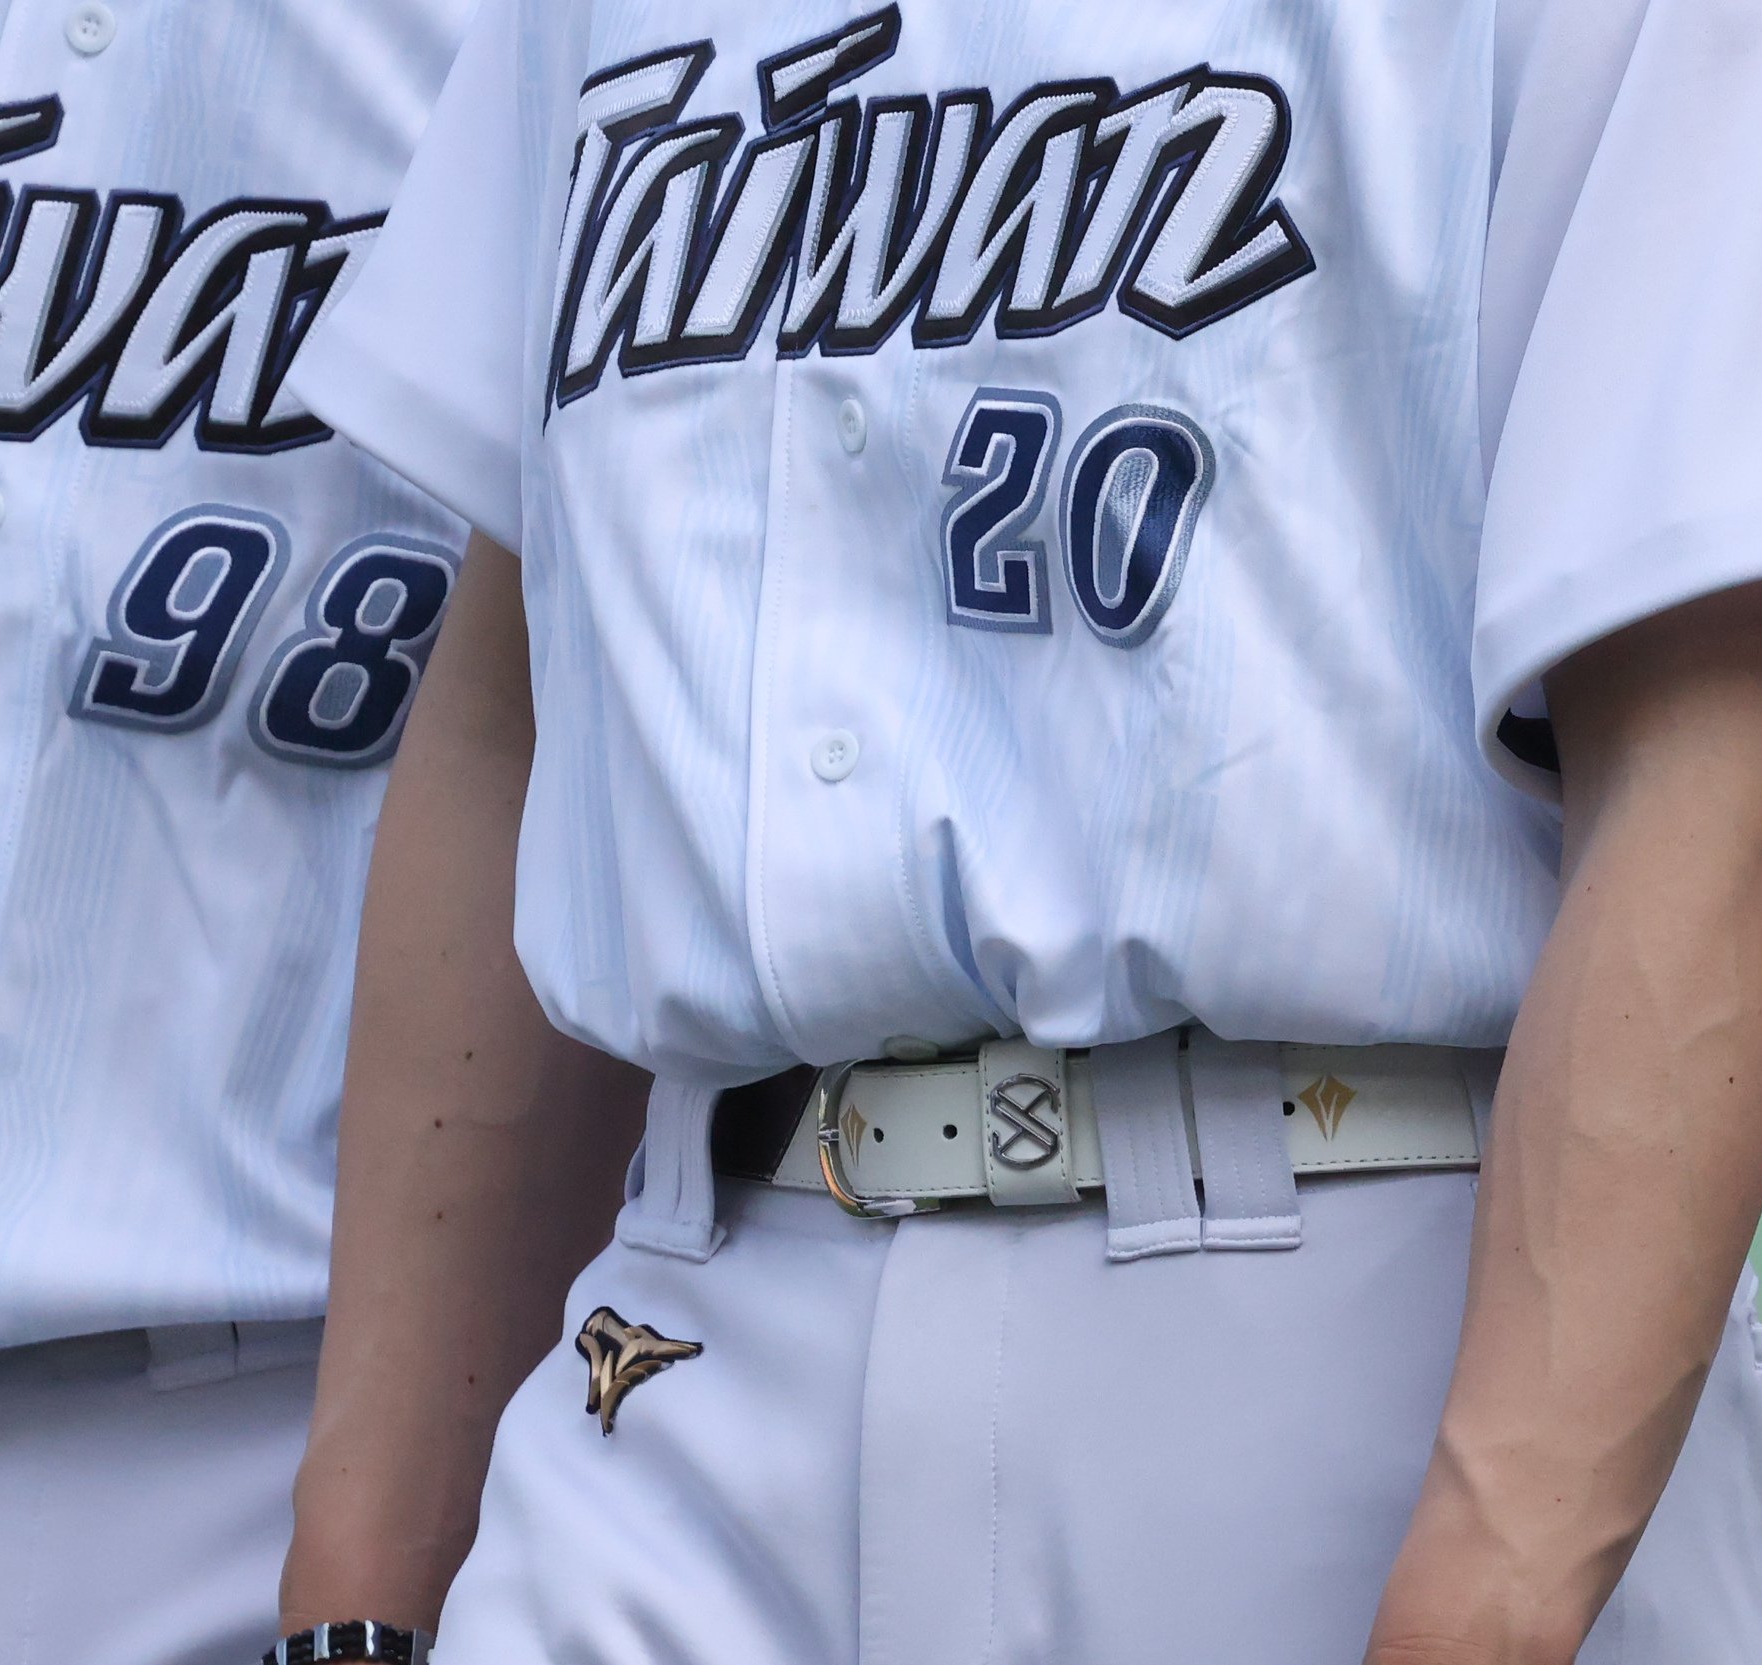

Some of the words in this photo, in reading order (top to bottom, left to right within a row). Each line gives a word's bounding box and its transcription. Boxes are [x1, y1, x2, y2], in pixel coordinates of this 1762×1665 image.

[542, 1, 1317, 436] Taiwan
[68, 502, 462, 770] 98
[941, 386, 1217, 650] 20
